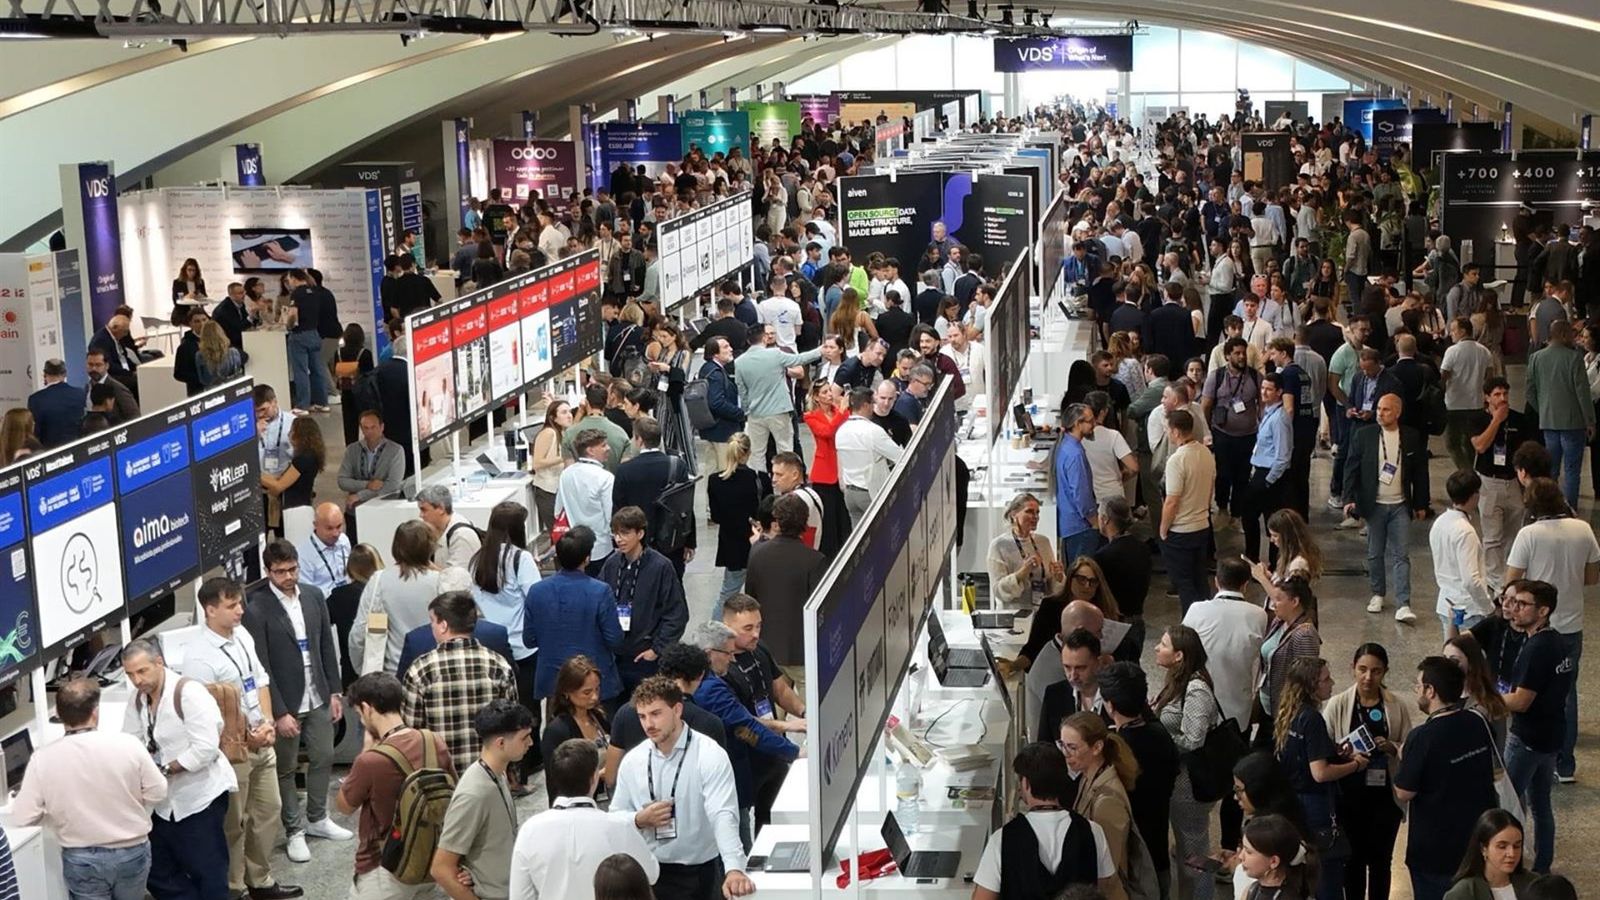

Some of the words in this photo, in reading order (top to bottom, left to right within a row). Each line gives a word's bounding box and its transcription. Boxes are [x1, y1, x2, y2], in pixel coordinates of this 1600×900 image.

[1067, 46, 1088, 56] Origin
[1089, 46, 1097, 54] of
[1067, 54, 1091, 62] What's
[511, 144, 557, 160] odoo
[847, 188, 867, 198] aiven
[848, 211, 868, 219] OPEN
[869, 209, 898, 218] SOURCE
[899, 207, 917, 216] DATA
[848, 216, 913, 228] INFRASTRUCTURE,
[848, 228, 870, 237] MADE
[871, 226, 899, 236] SIMPLE.
[133, 514, 170, 548] aima
